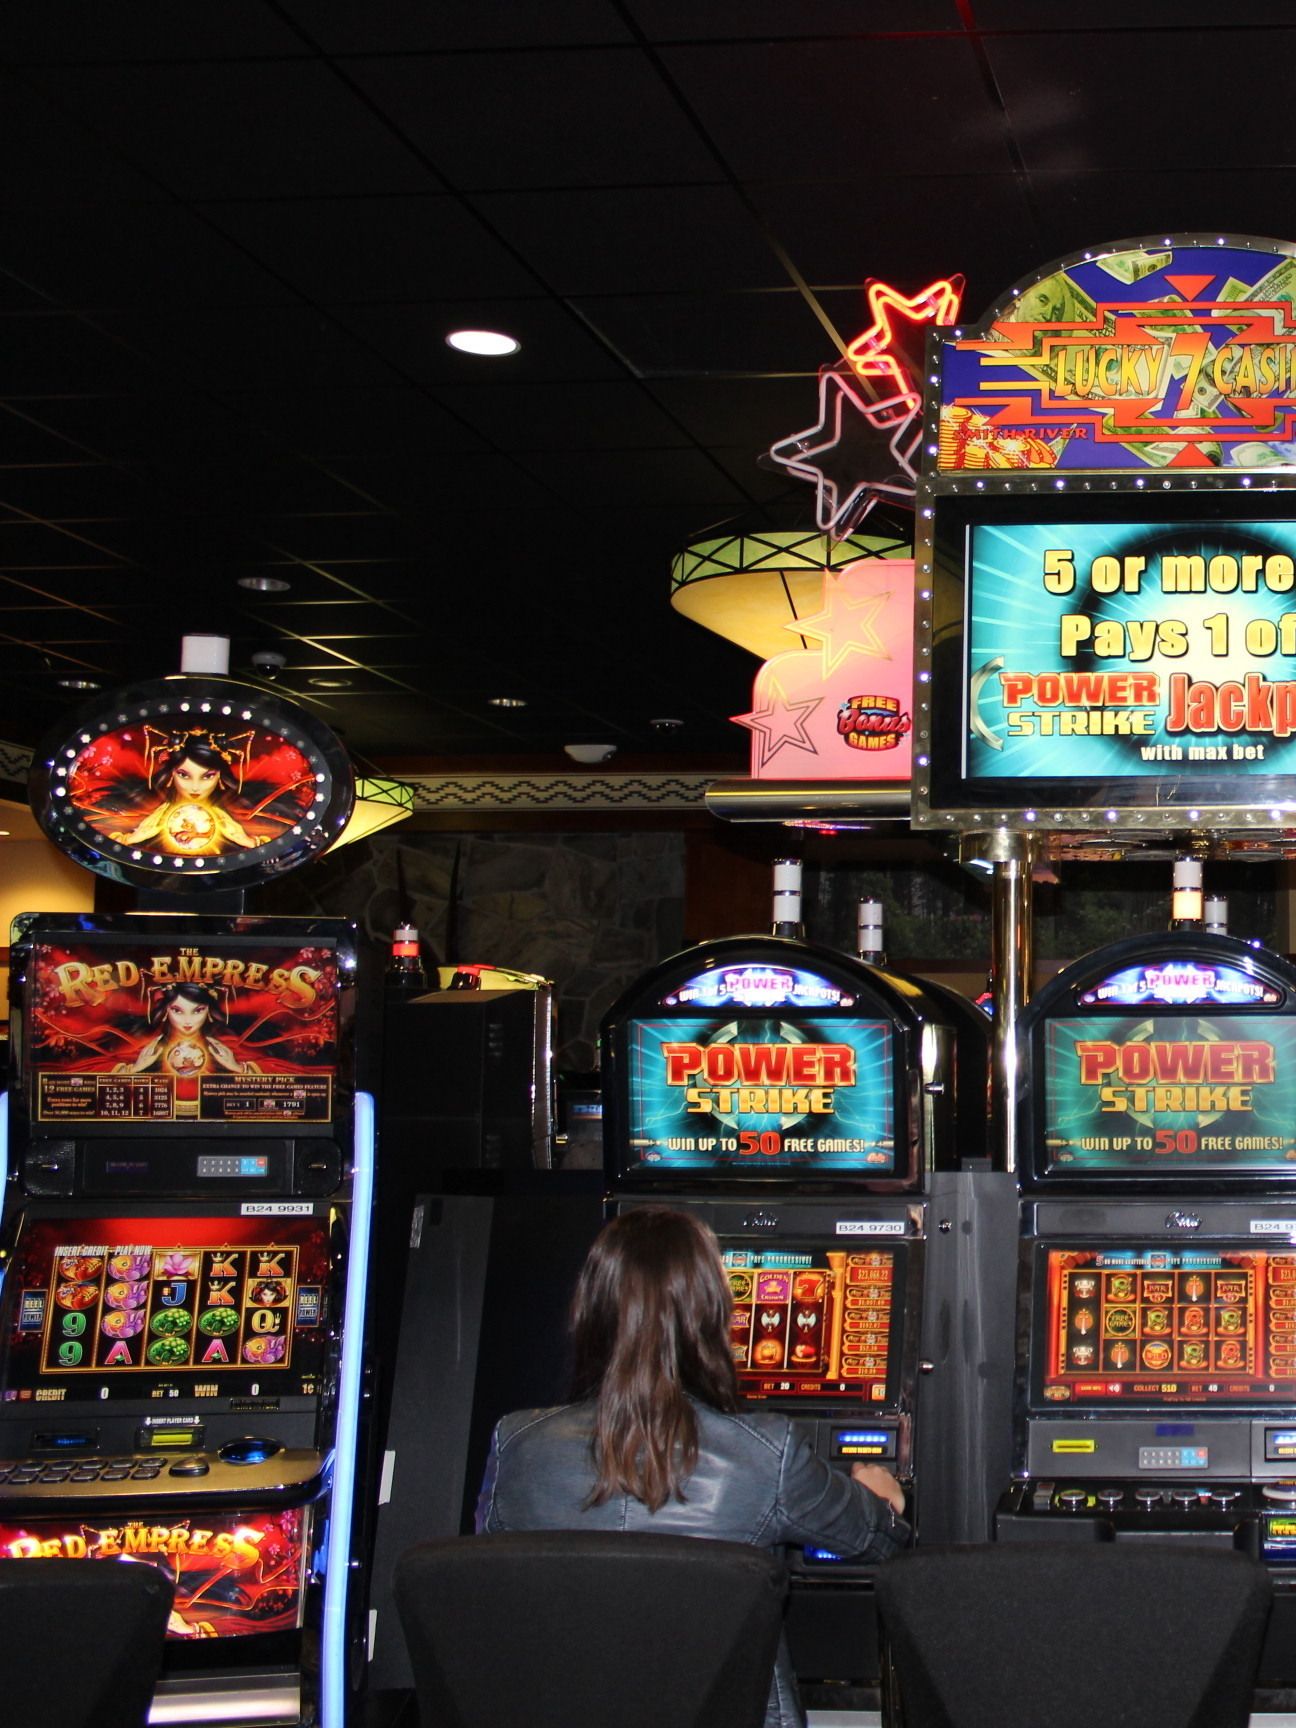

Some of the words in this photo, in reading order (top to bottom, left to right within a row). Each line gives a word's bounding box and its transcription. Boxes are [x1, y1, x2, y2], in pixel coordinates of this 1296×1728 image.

[1055, 346, 1163, 397] LUCKY
[1170, 332, 1211, 411] 7
[1024, 427, 1088, 439] RIVER
[1043, 549, 1075, 594] 5
[1091, 555, 1146, 594] or
[1161, 553, 1295, 594] more
[1060, 613, 1187, 662] Pays
[1203, 614, 1229, 657] 1
[1000, 671, 1160, 708] POWER
[849, 695, 898, 711] FREE
[837, 708, 912, 735] Bonus
[1007, 709, 1157, 737] STRIKE
[848, 733, 897, 750] GAMES
[1140, 743, 1184, 762] with
[1187, 746, 1228, 762] max
[1231, 743, 1265, 762] bet
[180, 947, 199, 956] THE
[54, 961, 140, 1007] RED
[150, 956, 322, 1009] EMPRESS
[727, 976, 791, 989] POWER
[1149, 974, 1214, 986] POWER
[661, 1042, 856, 1086] POWER
[1074, 1040, 1276, 1085] POWER
[686, 1088, 835, 1113] STRIKE
[1099, 1086, 1253, 1112] STRIKE
[668, 1137, 695, 1151] WIN
[699, 1138, 717, 1151] UP
[720, 1138, 737, 1151] TO
[738, 1131, 781, 1155] 50
[784, 1138, 814, 1151] FREE
[817, 1137, 864, 1152] GAMES!
[1081, 1137, 1109, 1150] WIN
[1113, 1137, 1131, 1150] UP
[1135, 1137, 1152, 1150] TO
[1154, 1129, 1197, 1154] 50
[1201, 1137, 1231, 1150] FREE
[1235, 1136, 1283, 1150] GAMES!
[246, 1205, 272, 1213] B24
[278, 1205, 311, 1213] 9931
[838, 1224, 864, 1232] B24
[868, 1224, 902, 1232] 9730
[1253, 1223, 1280, 1231] B24
[54, 1246, 80, 1256] INSERT
[81, 1246, 109, 1256] CREDIT
[115, 1246, 134, 1255] PLAY
[210, 1253, 238, 1277] K
[257, 1253, 285, 1277] K
[162, 1282, 187, 1306] J
[207, 1281, 235, 1305] K
[61, 1311, 87, 1337] 9
[59, 1340, 84, 1366] 9
[105, 1340, 134, 1366] A
[201, 1338, 230, 1364] A
[35, 1388, 67, 1401] CREDIT
[100, 1386, 110, 1400] 0
[152, 1390, 164, 1398] BET
[168, 1388, 179, 1398] 50
[194, 1384, 219, 1397] WIN
[250, 1383, 260, 1396] 0
[839, 1383, 846, 1391] 0
[1133, 1384, 1160, 1393] COLLECT
[1161, 1384, 1177, 1393] 510
[1268, 1384, 1275, 1393] 0
[96, 1526, 266, 1570] EMPRESS
